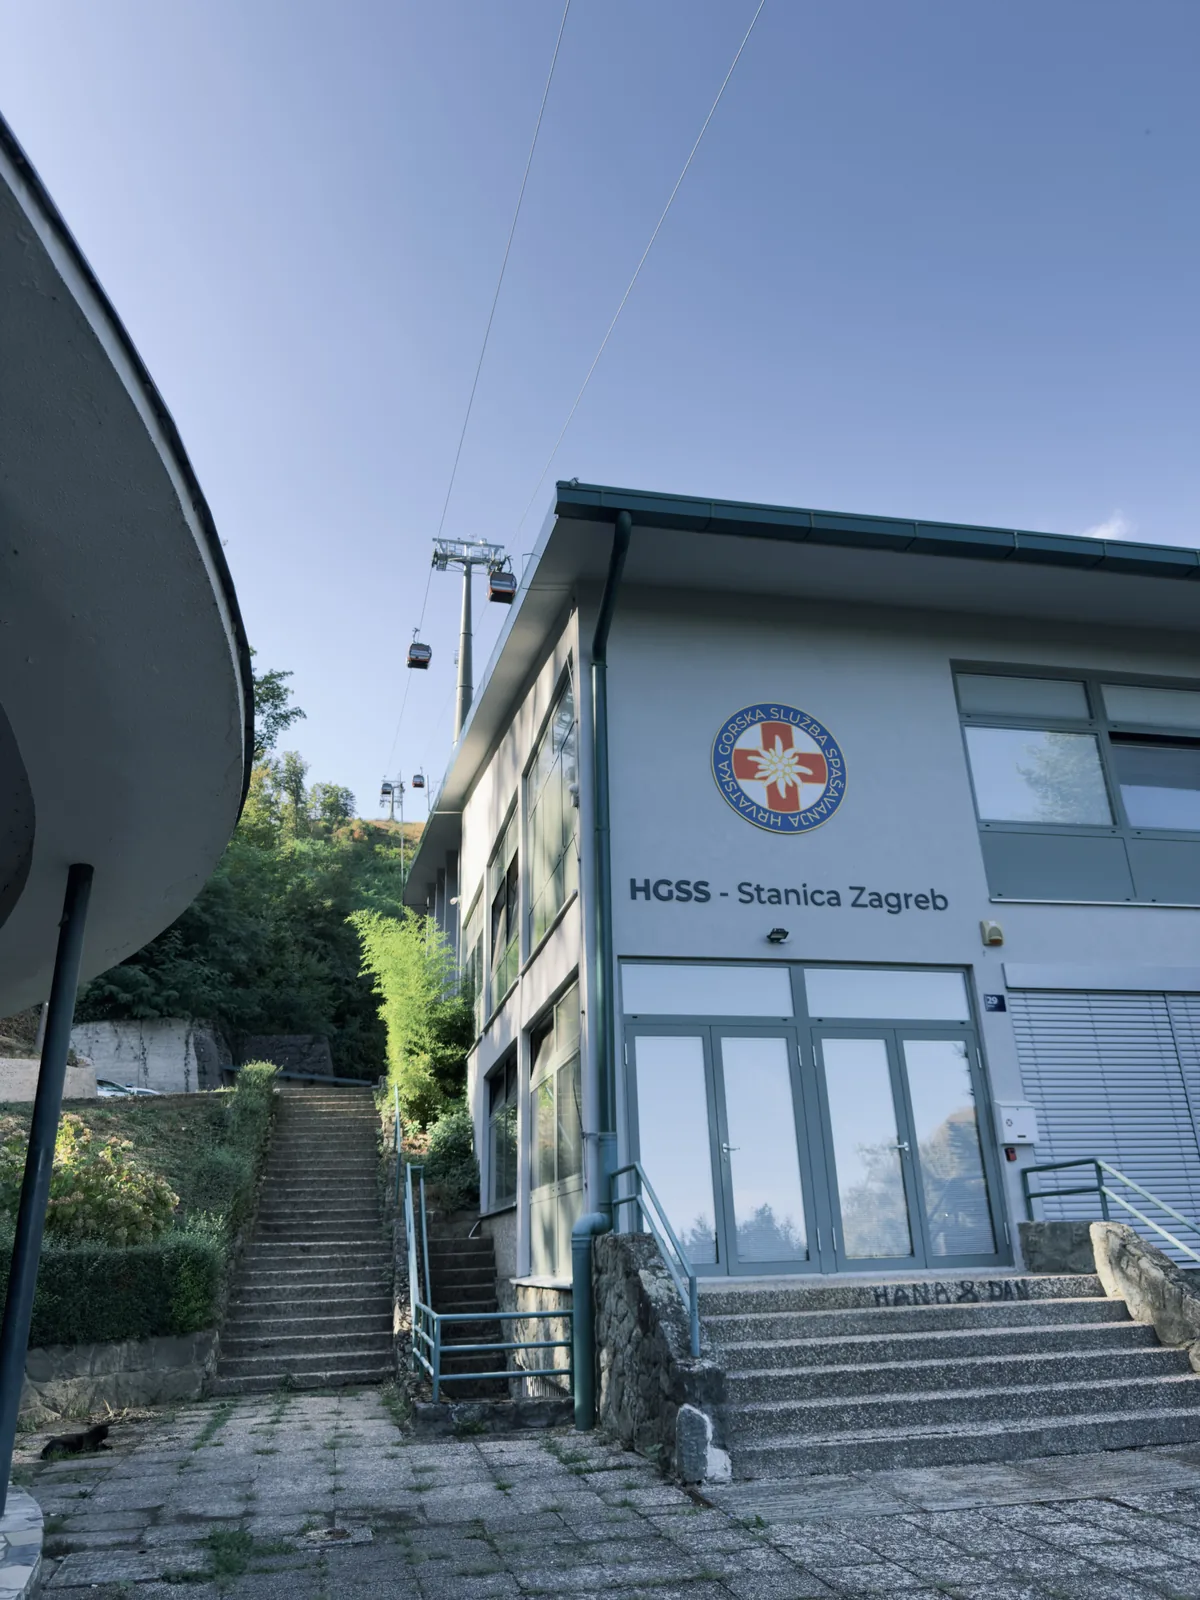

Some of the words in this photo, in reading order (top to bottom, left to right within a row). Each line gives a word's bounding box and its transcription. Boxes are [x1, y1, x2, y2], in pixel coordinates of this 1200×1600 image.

[718, 708, 767, 755] GORSKA
[769, 707, 828, 746] SLUŽBA
[718, 760, 781, 826] HRVATSKA
[788, 748, 844, 827] SPAŠAVANJA
[629, 878, 711, 902] HGSS
[737, 881, 842, 907] Stanica
[849, 885, 949, 914] Zagreb
[987, 996, 998, 1004] 29
[988, 1278, 1030, 1301] DAN
